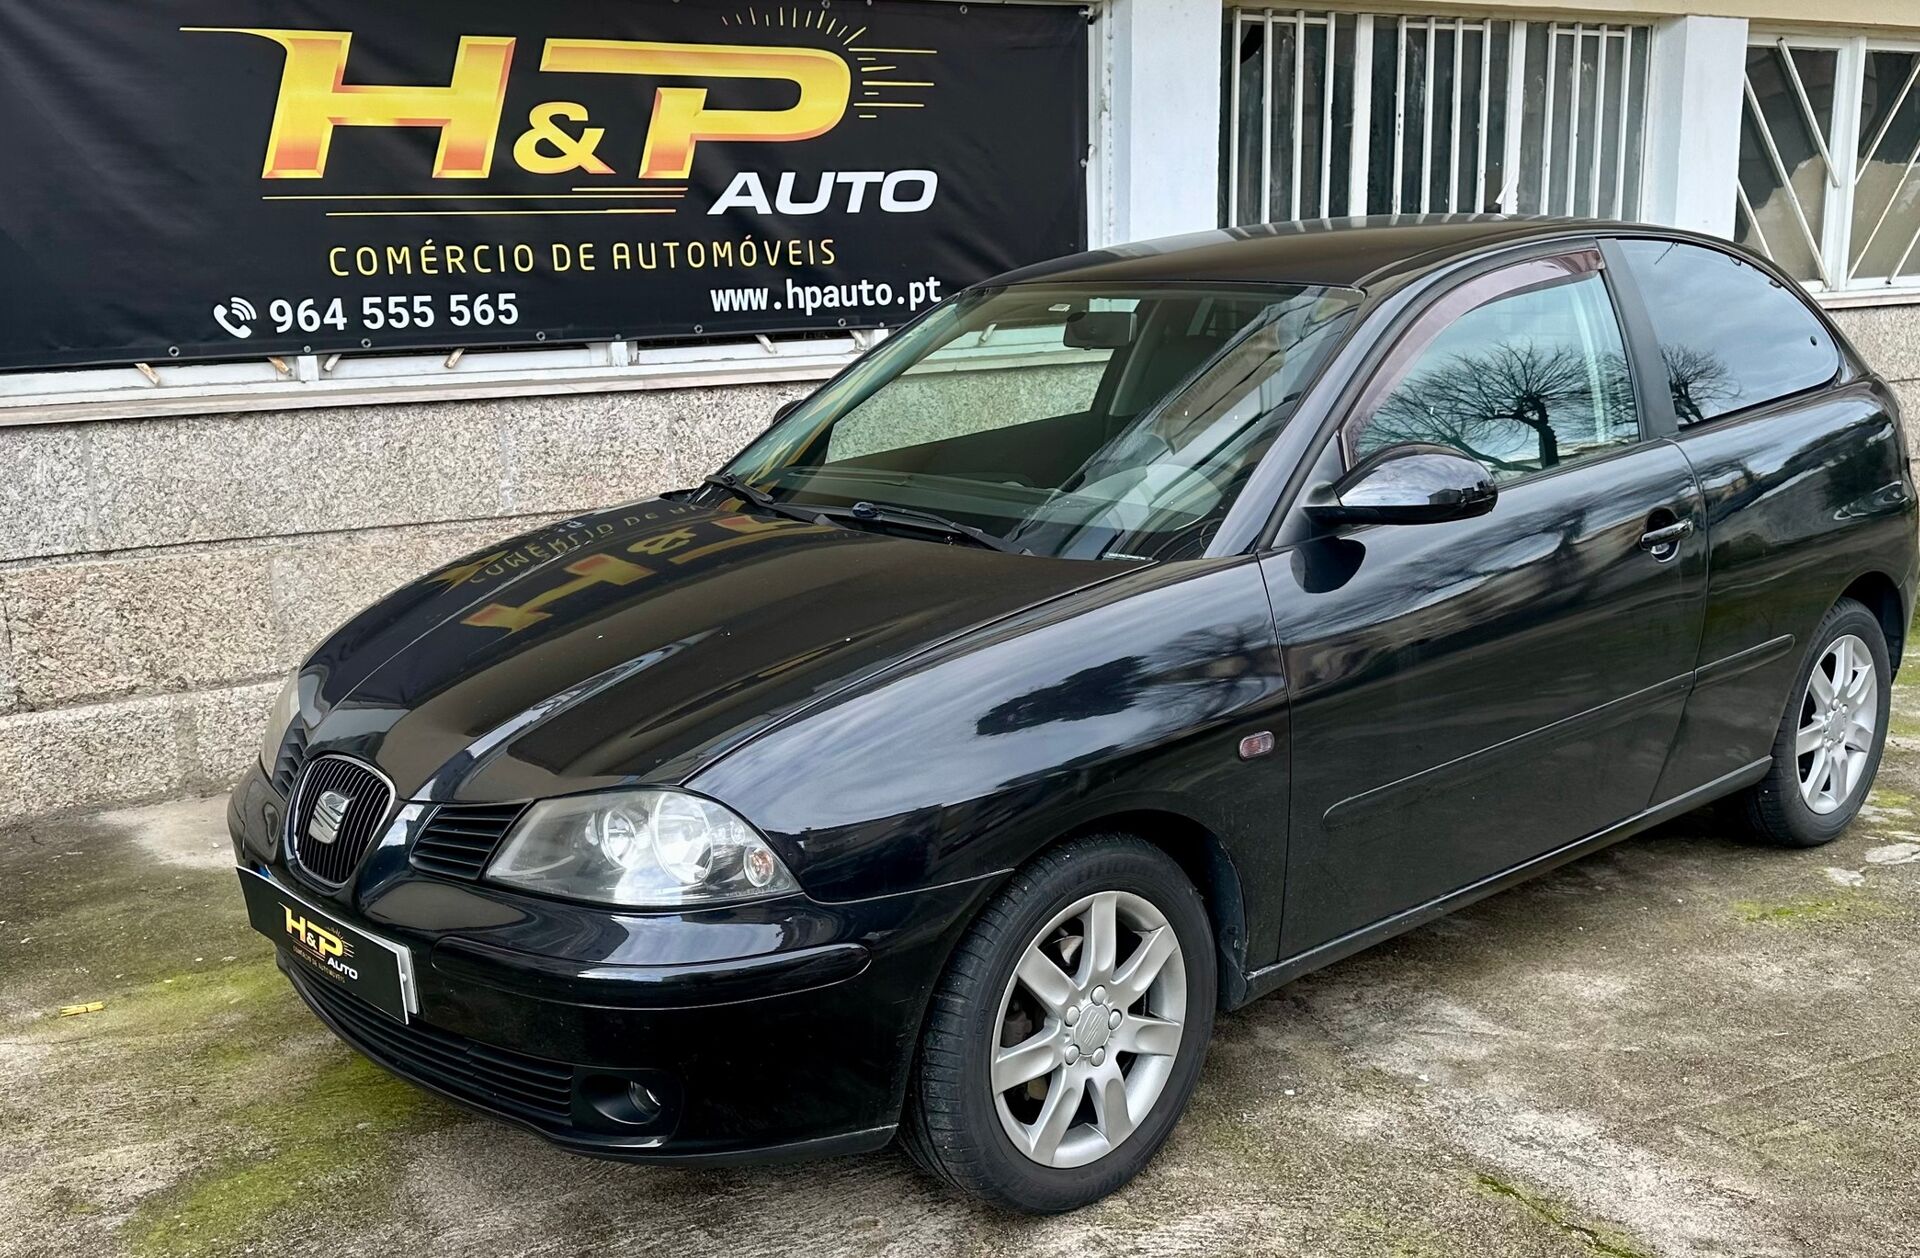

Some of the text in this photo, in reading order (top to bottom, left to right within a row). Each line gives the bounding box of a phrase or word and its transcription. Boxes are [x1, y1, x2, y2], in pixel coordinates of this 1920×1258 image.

[706, 169, 938, 216] AUTO
[329, 234, 836, 277] COMÉRCIO DE AUTOMÓVEIS
[269, 292, 519, 334] 964 555 565
[710, 277, 943, 317] www.hpauto.pt
[278, 902, 344, 957] H&P
[327, 956, 359, 981] AUTO
